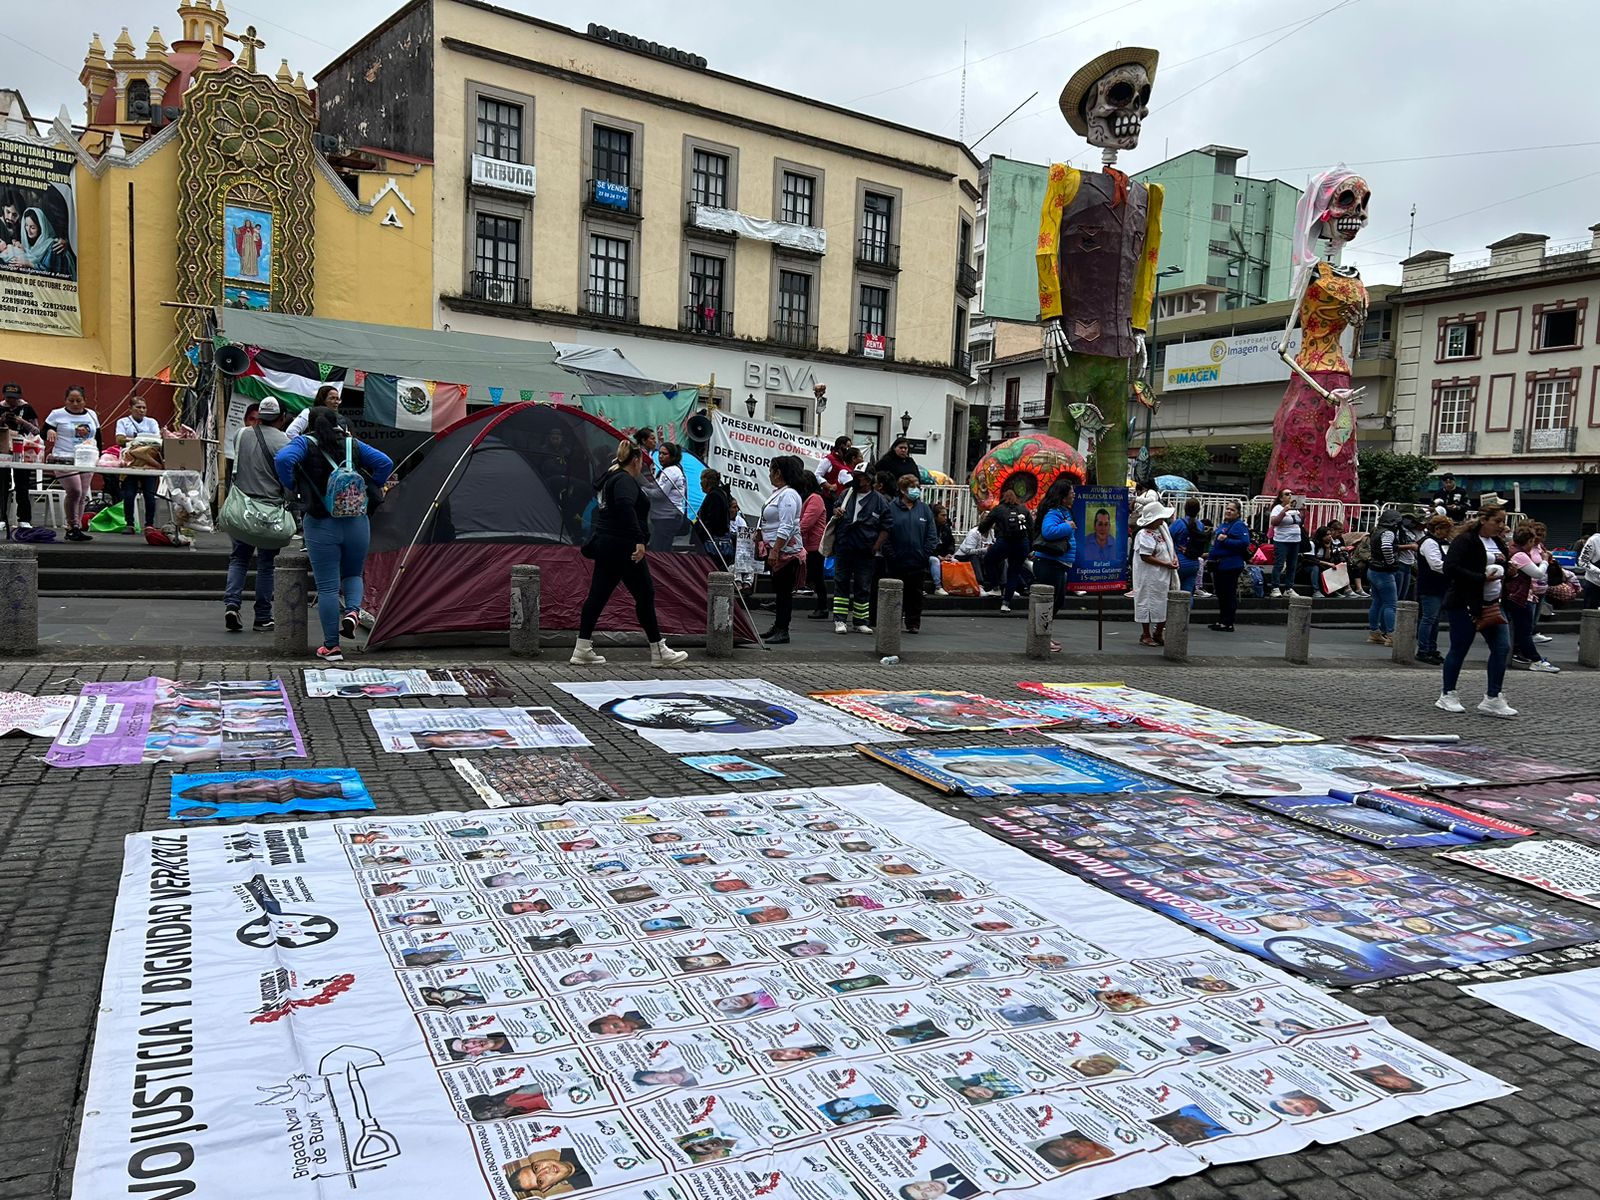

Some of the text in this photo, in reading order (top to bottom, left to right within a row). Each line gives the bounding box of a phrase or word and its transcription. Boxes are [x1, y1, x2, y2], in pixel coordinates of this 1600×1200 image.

[46, 149, 55, 160] DE
[5, 163, 45, 179] SUPERACIÓN
[476, 159, 533, 187] TRIBUNA
[596, 180, 629, 193] SE VENDE
[4, 288, 34, 298] INFORMES
[29, 278, 36, 287] DE
[37, 280, 61, 290] OCTUBRE
[62, 284, 77, 293] 2023
[866, 340, 884, 349] RENTA
[1227, 344, 1258, 357] Imagen
[1259, 344, 1269, 352] del
[744, 360, 820, 393] BBVA
[1176, 369, 1218, 385] IMAGEN
[721, 416, 796, 442] PRESENTACIÓN
[798, 435, 818, 448] CON
[728, 431, 775, 448] FIDENCIO
[778, 442, 812, 456] GÓMEZ
[713, 446, 770, 467] DEFENSOR
[727, 463, 757, 479] DE LA
[722, 474, 760, 493] TIERRA
[1076, 567, 1101, 575] Espinosa
[150, 834, 192, 902] VERACRUZ
[981, 815, 1260, 935] Colectivo Madres Luna
[142, 904, 193, 995] DIGNIDAD
[140, 1000, 193, 1017] Y
[131, 1018, 208, 1143] JUSTICIA
[288, 1133, 312, 1179] Brigada
[311, 1147, 328, 1165] de
[495, 1134, 515, 1160] OSVALDO
[508, 1139, 526, 1159] GARCÍA
[859, 1133, 908, 1179] AYALA CARREÑO
[852, 1142, 893, 1178] JUAN OFELIO
[696, 1170, 727, 1196] ANTONIO
